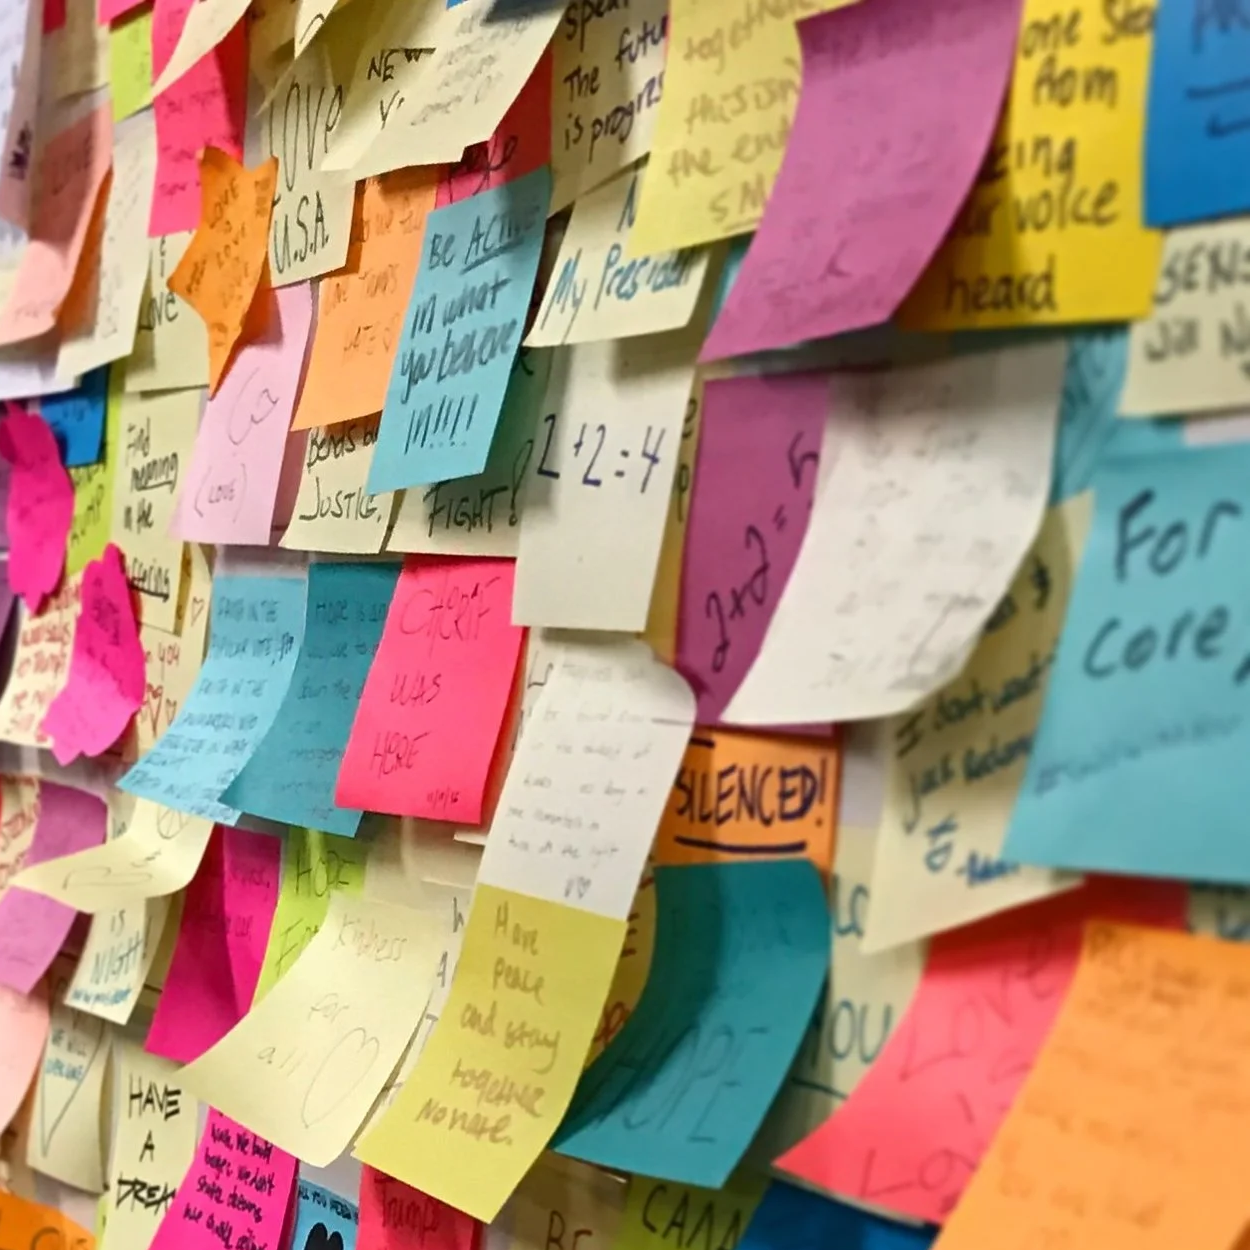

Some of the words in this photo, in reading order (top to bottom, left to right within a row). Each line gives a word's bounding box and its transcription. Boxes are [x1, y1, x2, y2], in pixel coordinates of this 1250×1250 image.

[672, 756, 828, 828] SILENCED!
[129, 1074, 182, 1121] HAVE
[139, 1130, 156, 1162] A
